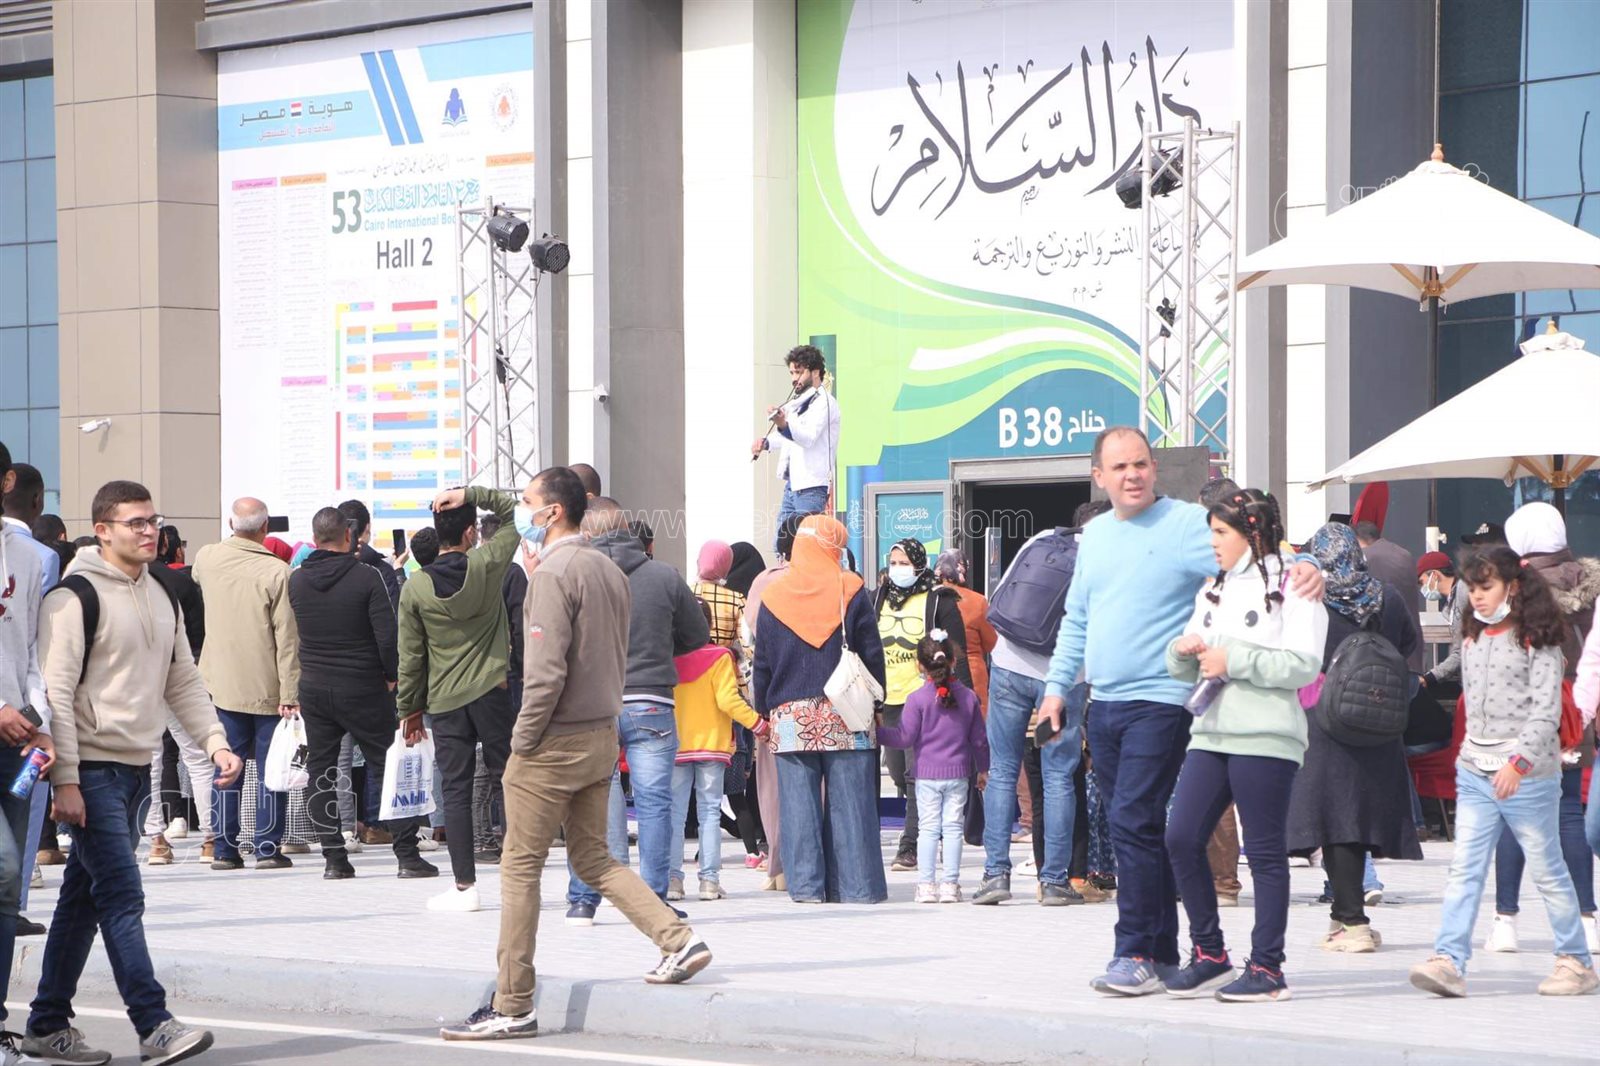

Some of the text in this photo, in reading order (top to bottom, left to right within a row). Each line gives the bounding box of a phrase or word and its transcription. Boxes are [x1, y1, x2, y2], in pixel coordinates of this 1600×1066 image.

[239, 99, 354, 127] هوية مصر
[332, 189, 362, 235] 53
[364, 219, 386, 232] Cairo
[387, 214, 439, 230] International
[441, 212, 459, 225] Boo
[377, 237, 434, 270] Hall 2
[1067, 409, 1107, 443] جناح
